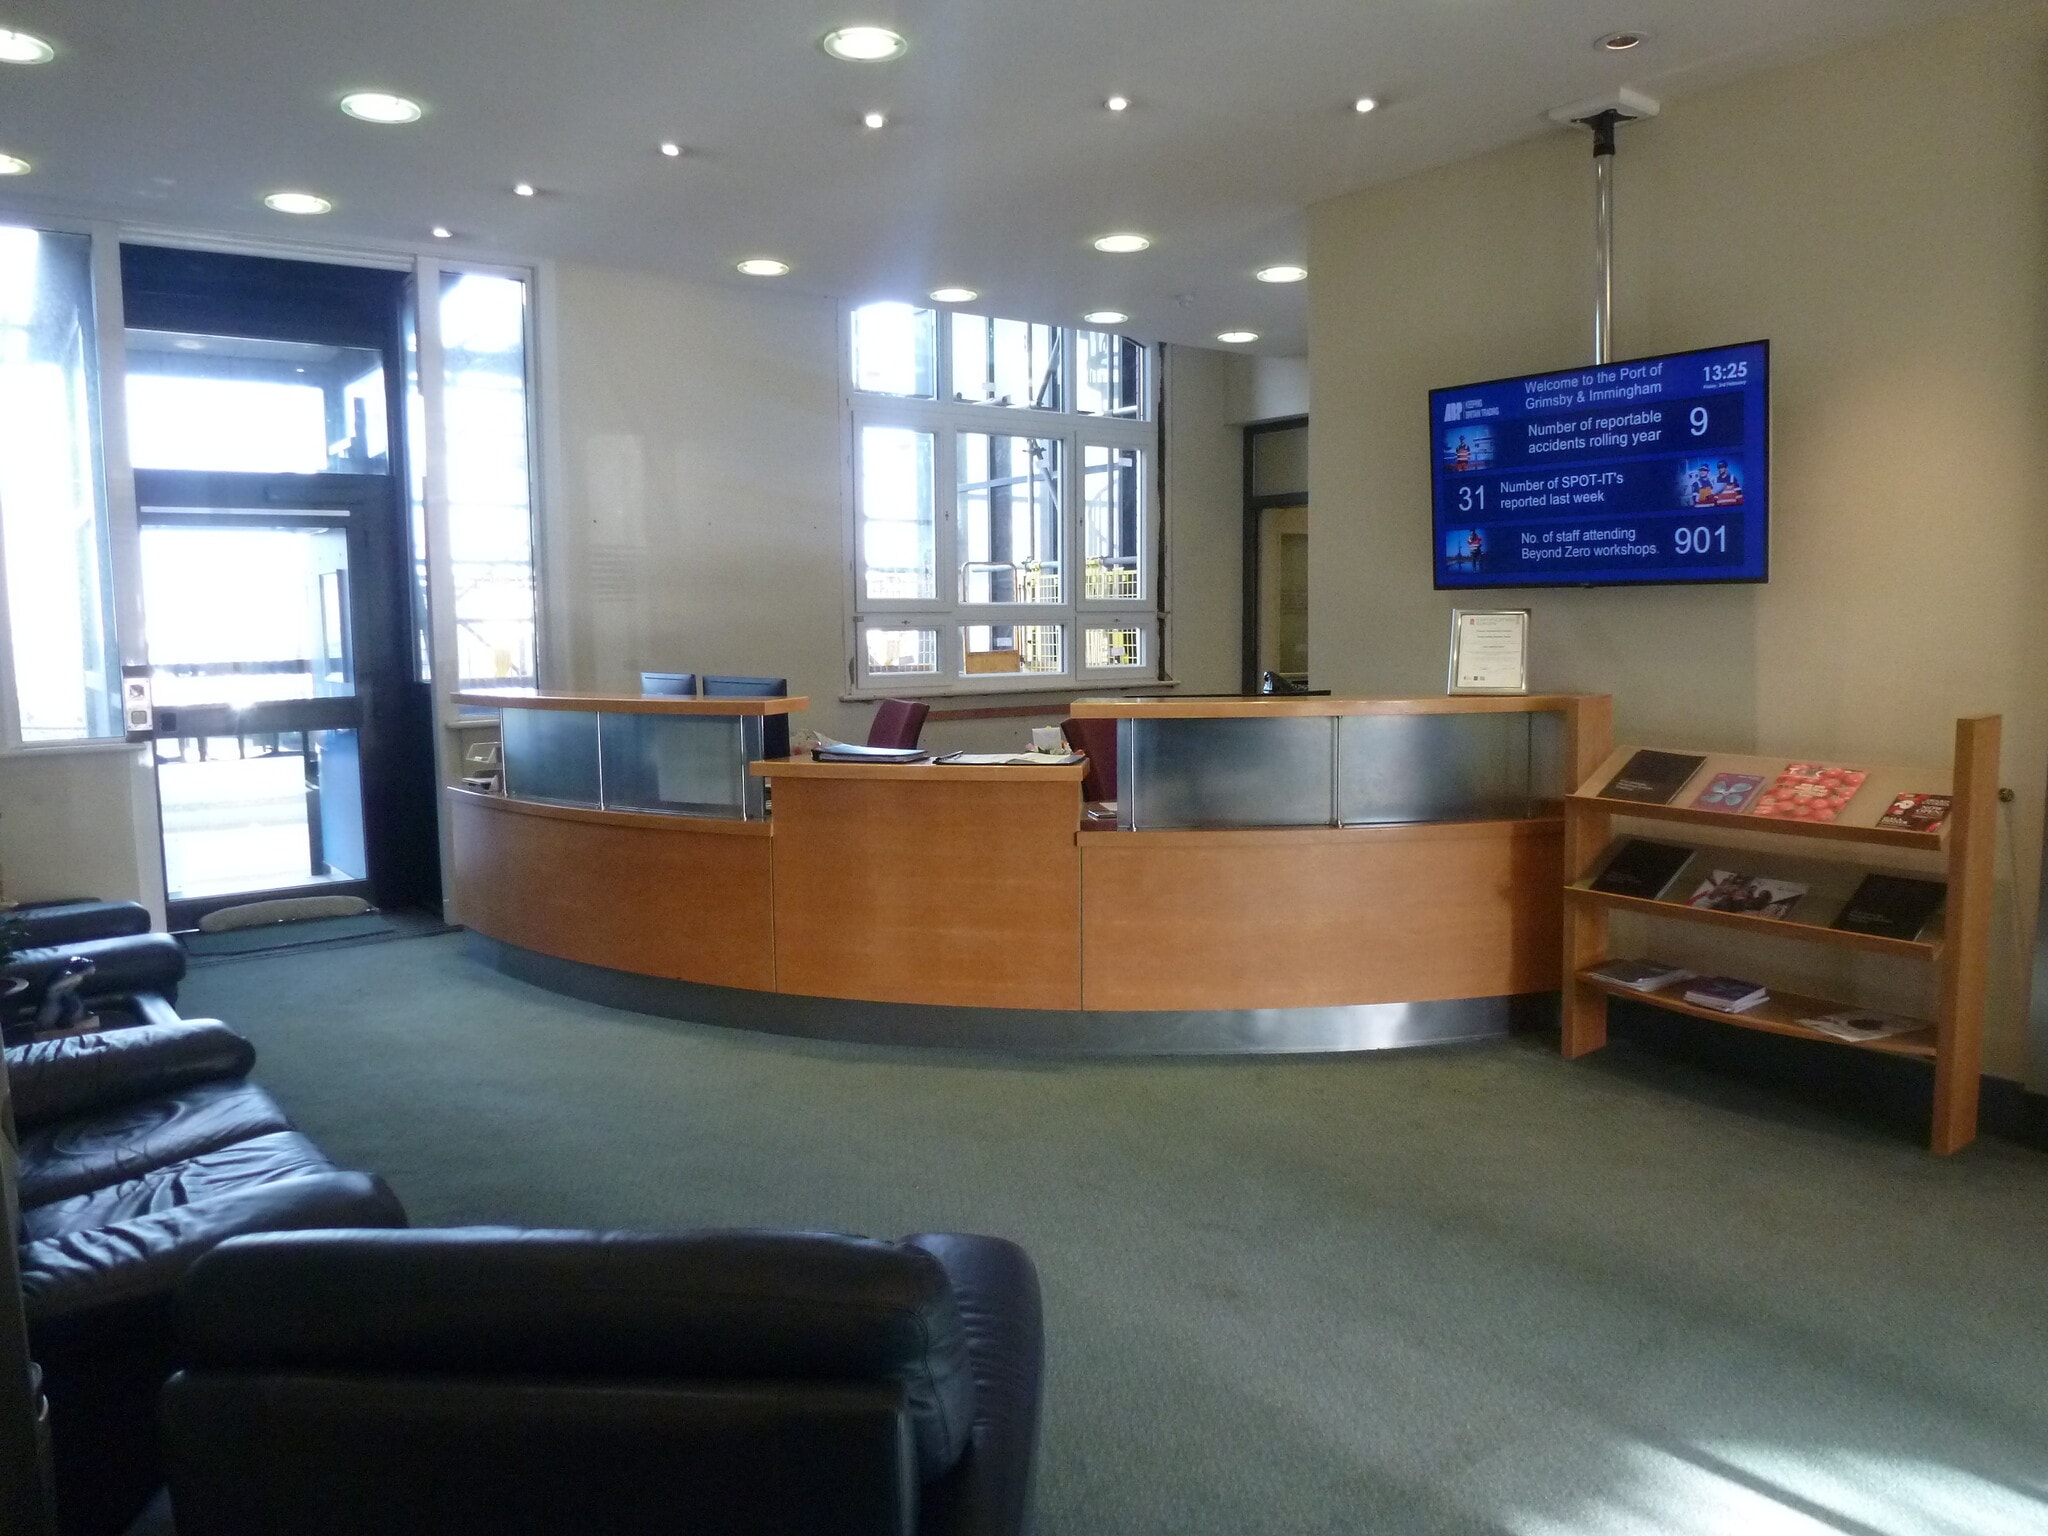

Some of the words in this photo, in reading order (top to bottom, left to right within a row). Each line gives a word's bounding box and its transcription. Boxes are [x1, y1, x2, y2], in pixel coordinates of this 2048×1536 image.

[1525, 377, 1579, 394] Welcome
[1582, 374, 1594, 385] to
[1597, 371, 1616, 383] the
[1620, 366, 1646, 380] Port
[1650, 362, 1663, 376] of
[1703, 361, 1748, 381] 13:25
[1525, 394, 1573, 410] Grimsby
[1576, 390, 1586, 402] &
[1589, 382, 1662, 401] Immingham
[1528, 421, 1577, 437] Number
[1579, 417, 1593, 431] of
[1595, 410, 1662, 431] reportable
[1689, 406, 1709, 436] 9
[1528, 436, 1586, 454] accidents
[1589, 433, 1628, 448] rolling
[1631, 429, 1662, 446] year
[1500, 480, 1545, 493] Number
[1547, 477, 1559, 490] of
[1561, 472, 1624, 489] SPOT-IT's
[1458, 485, 1485, 511] 31
[1500, 494, 1546, 511] reported
[1549, 492, 1570, 505] last
[1573, 490, 1605, 503] week
[1521, 532, 1539, 544] No.
[1542, 530, 1553, 543] of
[1556, 529, 1580, 543] staff
[1582, 528, 1636, 542] attending
[1674, 525, 1726, 554] 901
[1521, 546, 1562, 562] Beyond
[1564, 545, 1591, 558] Zero
[1593, 543, 1660, 557] workshops.
